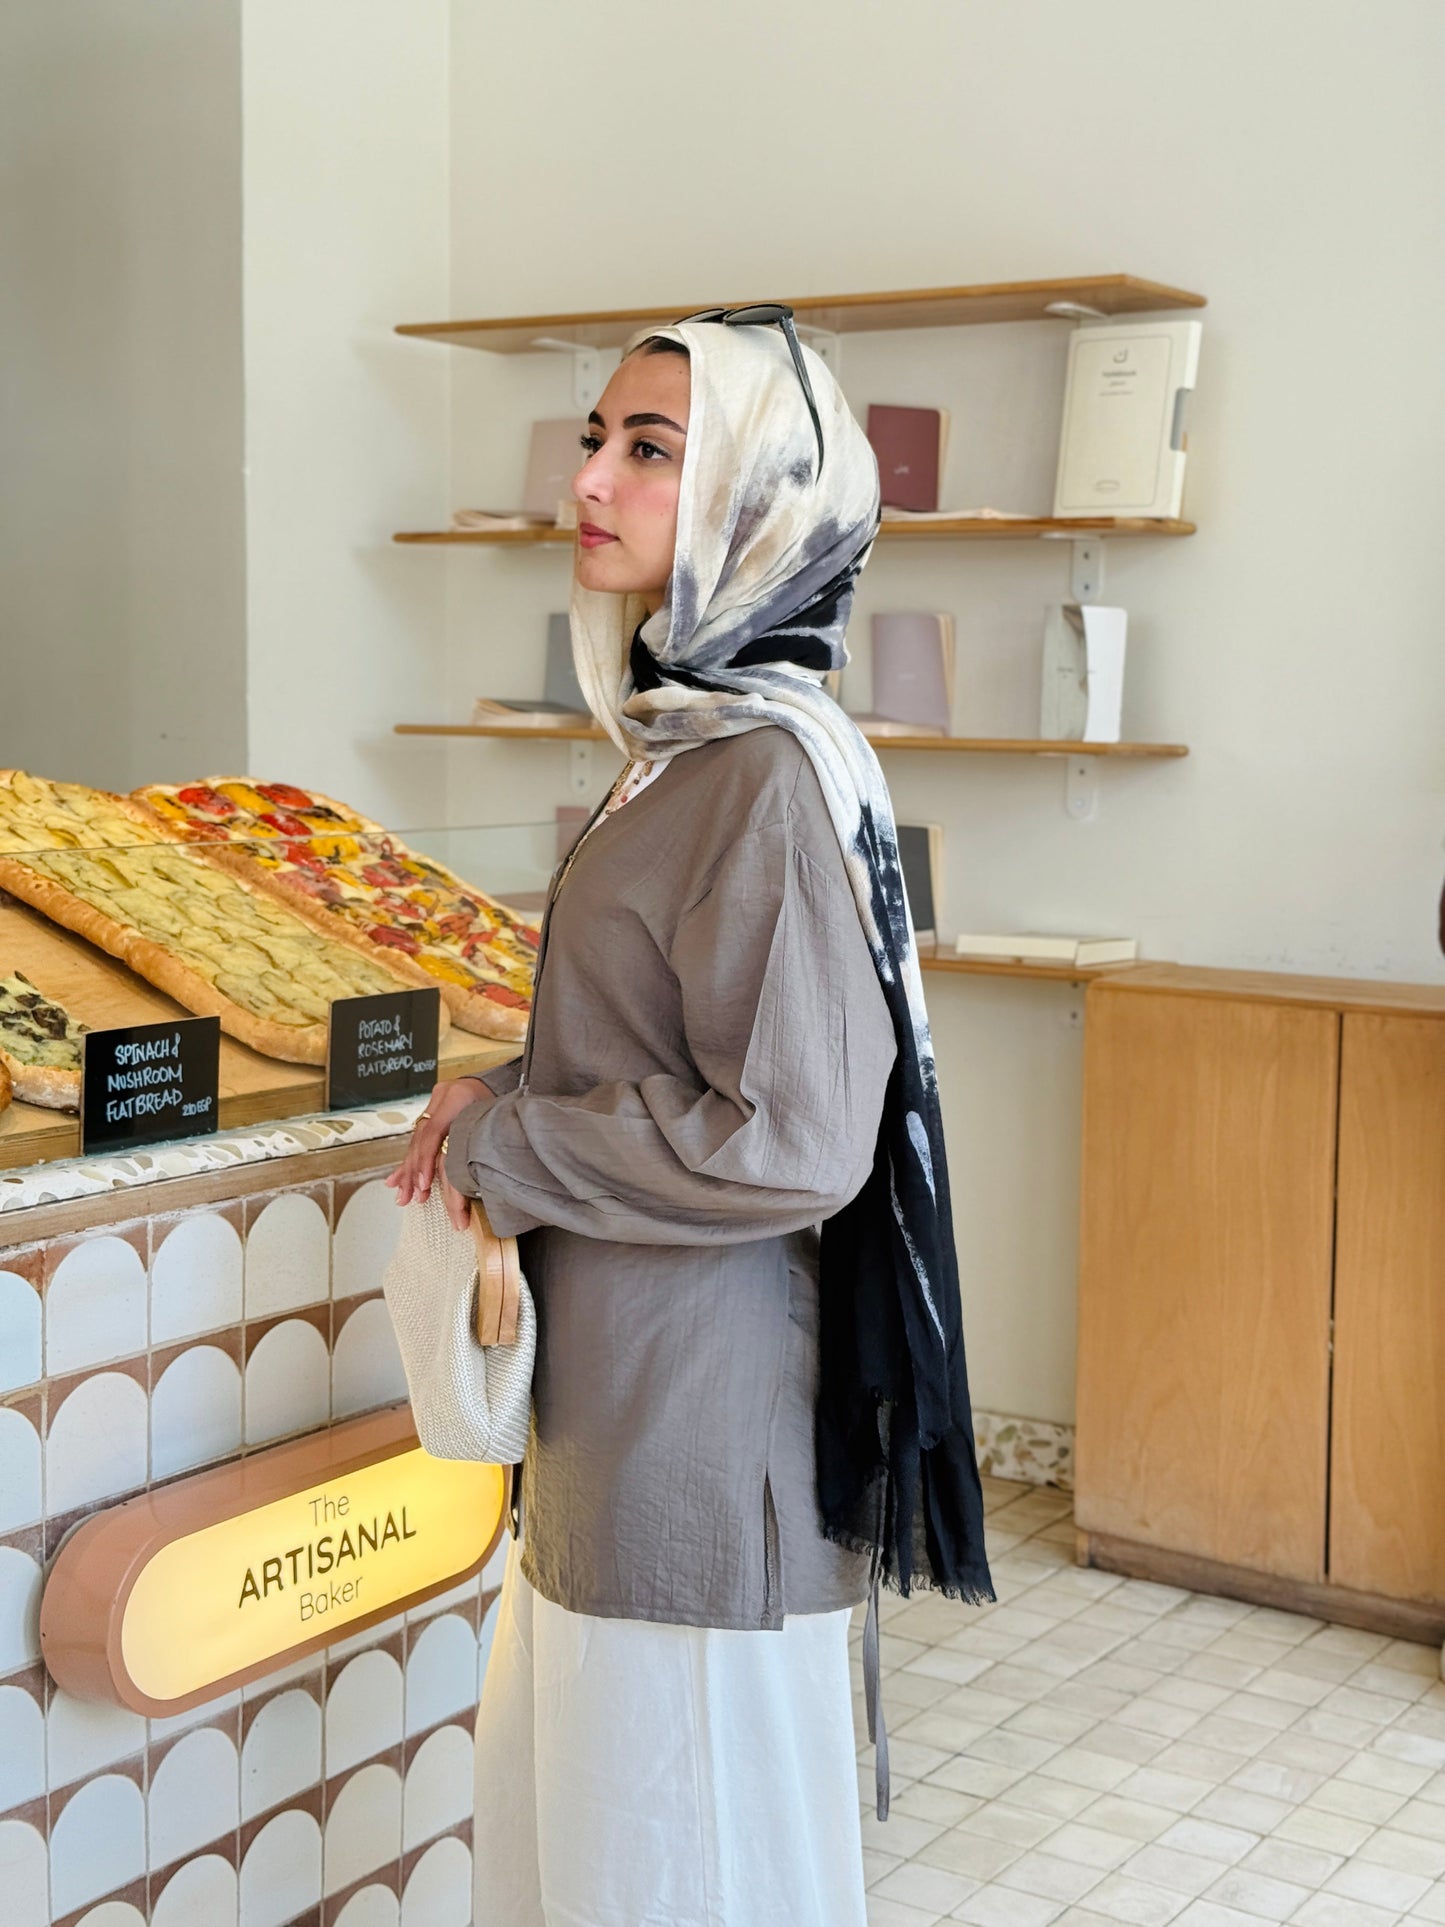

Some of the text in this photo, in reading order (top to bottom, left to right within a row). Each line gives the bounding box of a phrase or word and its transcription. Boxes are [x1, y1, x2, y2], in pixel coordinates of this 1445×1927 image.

[359, 1014, 401, 1039] POTATO &
[115, 1032, 181, 1066] SPINACH &
[357, 1031, 413, 1059] ROSEMARY
[107, 1063, 183, 1093] MUSHROOM
[357, 1055, 413, 1078] FLATBREAD
[106, 1087, 183, 1123] FLATBREAD
[308, 1494, 350, 1527] The
[238, 1505, 417, 1609] ARTISANAL
[299, 1576, 364, 1622] Baker
